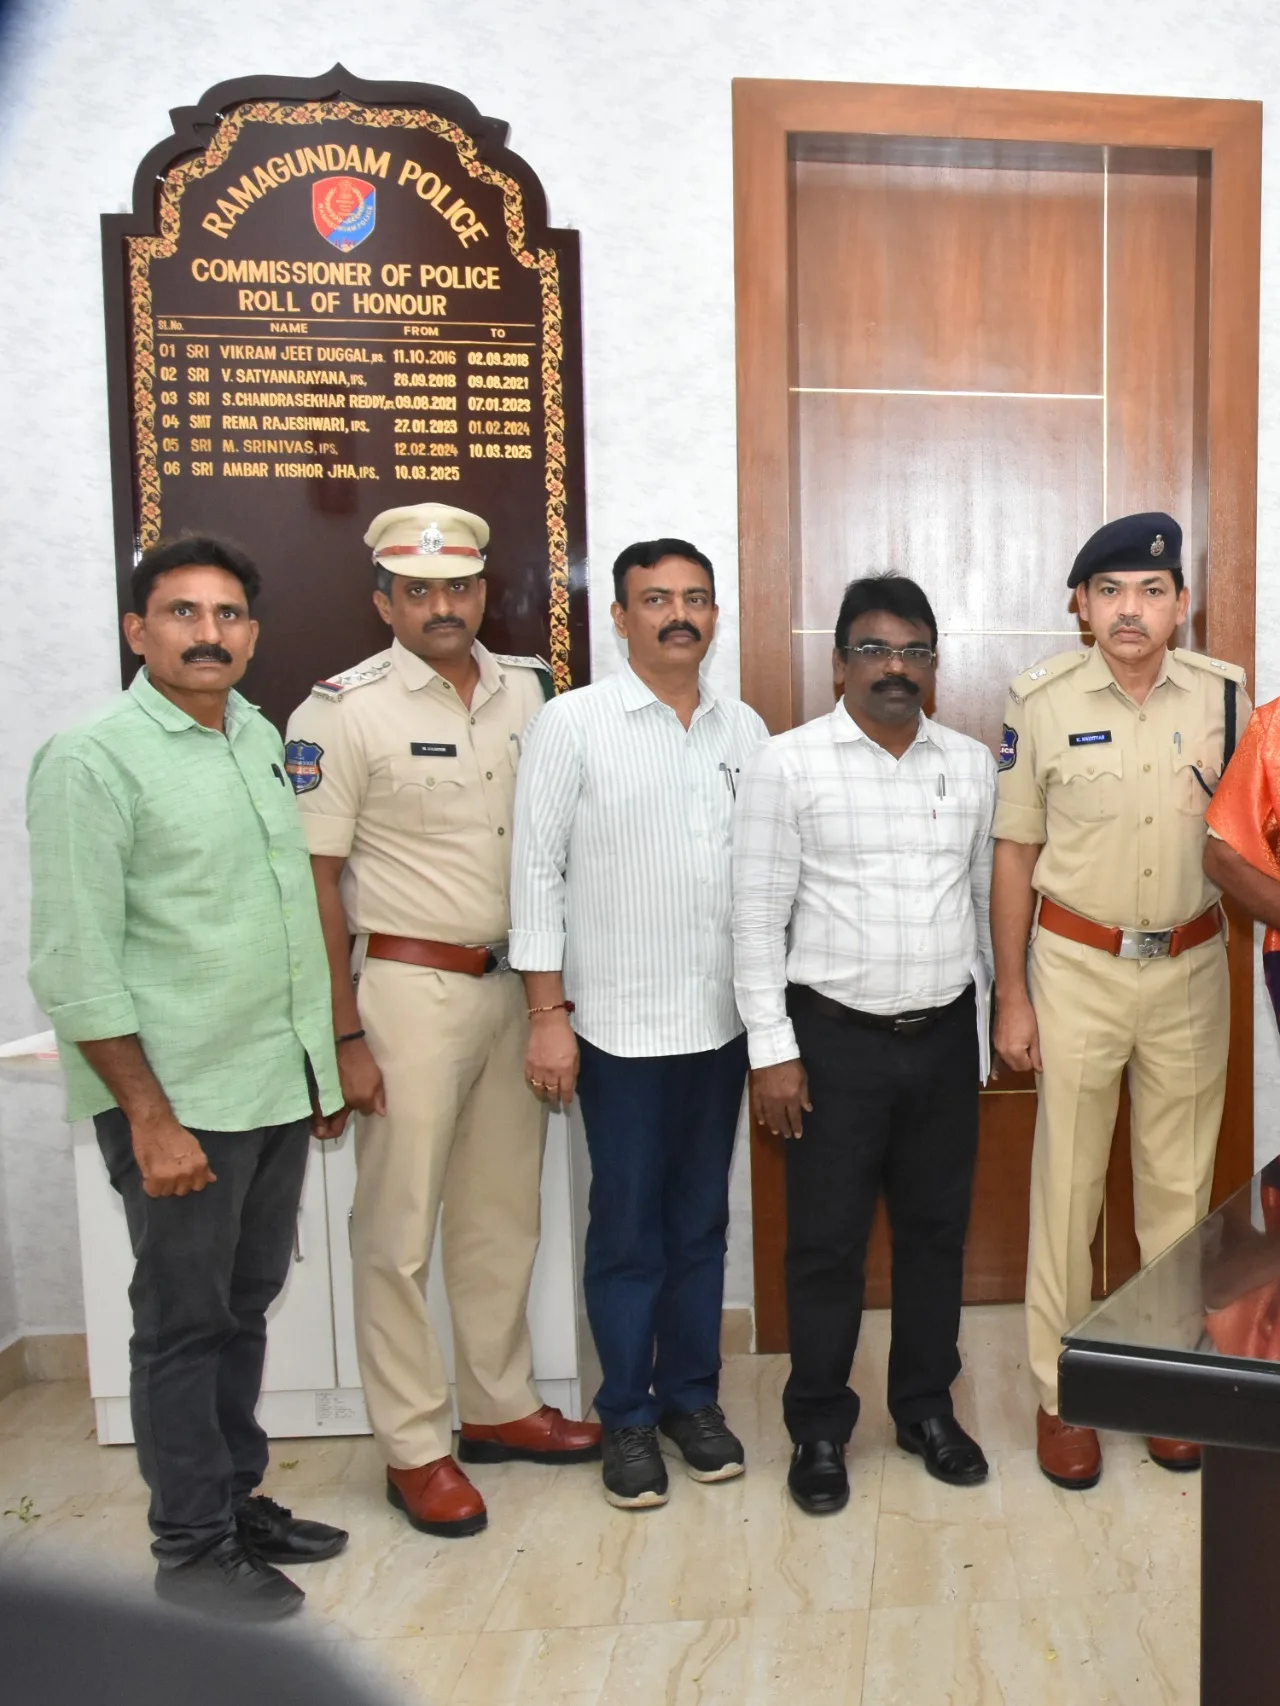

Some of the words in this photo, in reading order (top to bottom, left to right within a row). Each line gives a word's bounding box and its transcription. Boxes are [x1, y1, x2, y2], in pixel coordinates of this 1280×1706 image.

[202, 144, 391, 239] RAMAGUNDAM
[398, 160, 489, 249] POLICE
[191, 258, 371, 286] COMMISSIONER
[381, 263, 412, 287] OF
[420, 264, 501, 290] POLICE
[239, 289, 300, 312] ROLL
[311, 291, 340, 313] OF
[353, 292, 447, 316] HONOUR
[270, 323, 308, 333] NAME
[404, 326, 439, 336] FROM
[490, 328, 506, 338] TO
[159, 343, 176, 358] 01
[186, 344, 209, 358] SRI
[219, 345, 276, 360] VIKRAM
[281, 346, 313, 361] JEET
[393, 349, 457, 365] 11.10.2016
[467, 352, 529, 367] 02.09.2018
[160, 367, 177, 381] 02
[187, 367, 209, 382] SRI
[221, 368, 233, 382] V.
[394, 372, 457, 388] 26.09.2018
[467, 375, 529, 390] 09.08.2021
[161, 391, 178, 405] 03
[188, 391, 210, 406] SRI
[222, 392, 345, 408] S.CHANDRASEKHAR
[468, 397, 531, 412] 07.01.2023
[162, 414, 180, 429] 04
[189, 415, 211, 429] SMT
[222, 415, 258, 430] REMA
[394, 419, 457, 434] 27.01.2023
[468, 420, 530, 436] 01.02.2024
[162, 438, 179, 452] 05
[191, 438, 211, 452] SRI
[222, 439, 239, 453] M.
[394, 442, 458, 457] 12.02.2024
[469, 443, 532, 459] 10.03.2025
[163, 461, 180, 476] 06
[191, 461, 213, 476] SRI
[223, 462, 268, 477] AMBAR
[275, 463, 323, 478] KISHOR
[395, 465, 460, 481] 10.03.2025
